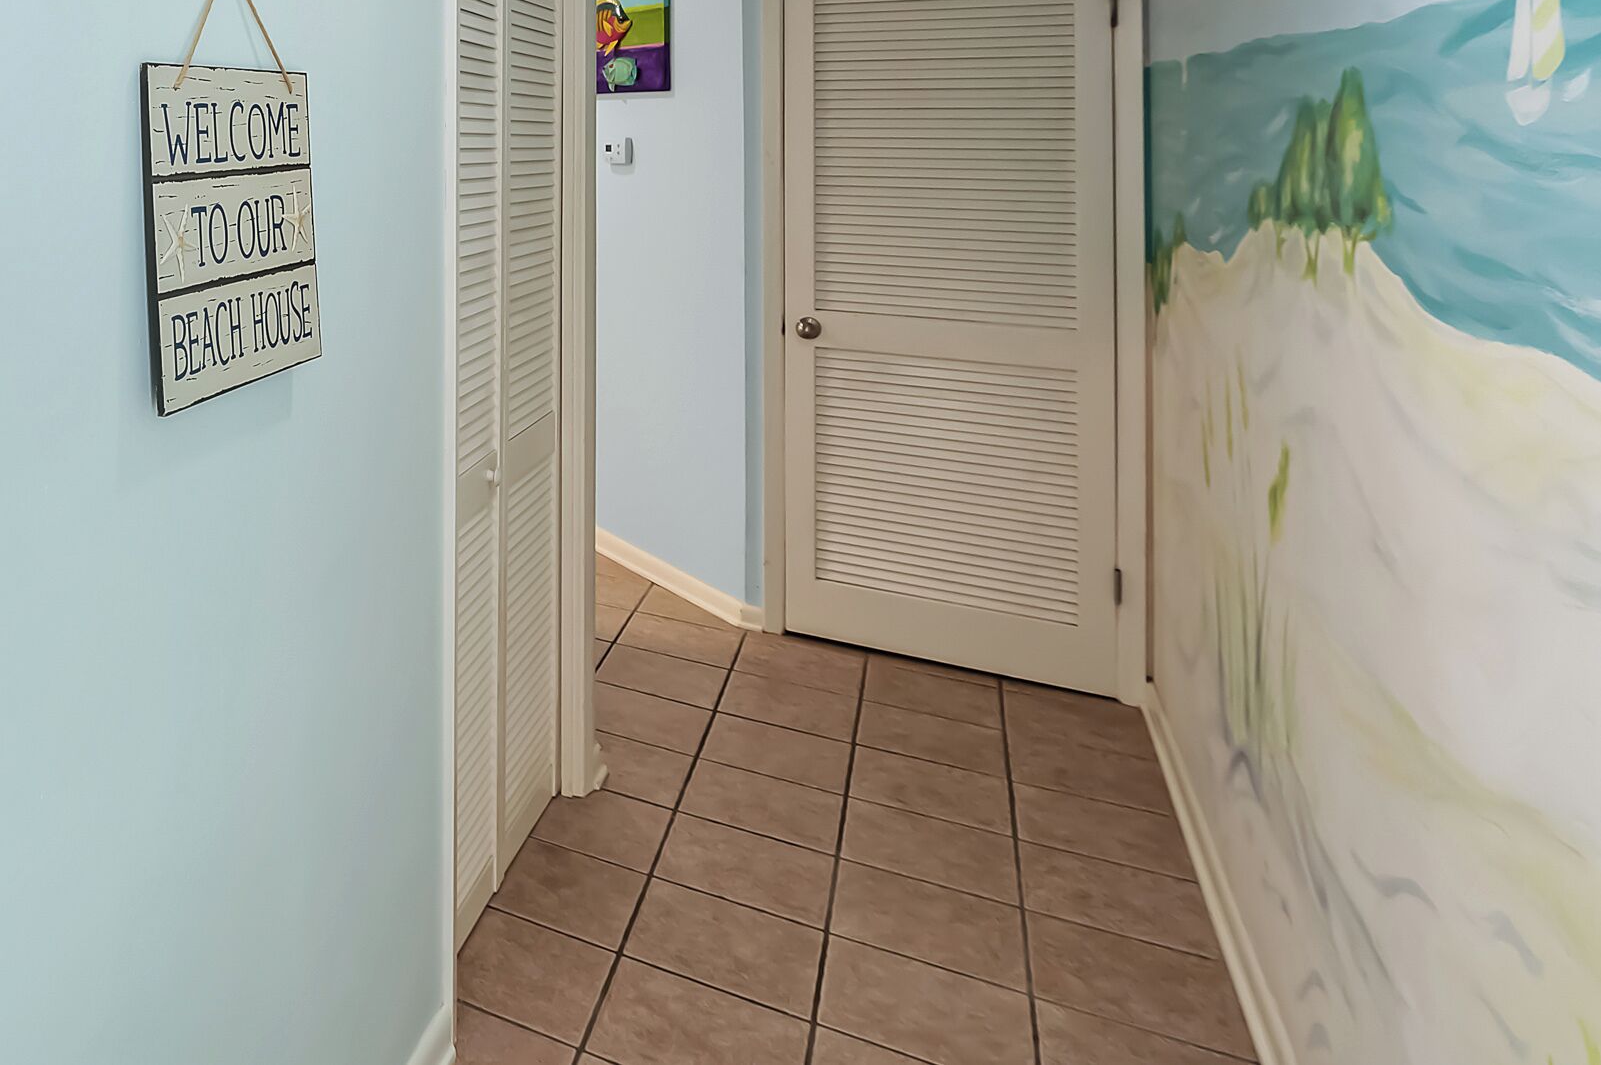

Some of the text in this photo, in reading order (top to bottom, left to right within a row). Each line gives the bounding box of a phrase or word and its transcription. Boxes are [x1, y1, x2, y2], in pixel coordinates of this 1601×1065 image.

[161, 101, 302, 166] WELCOME
[191, 194, 287, 267] TO OUR
[171, 280, 313, 381] BEACH HOUSE
